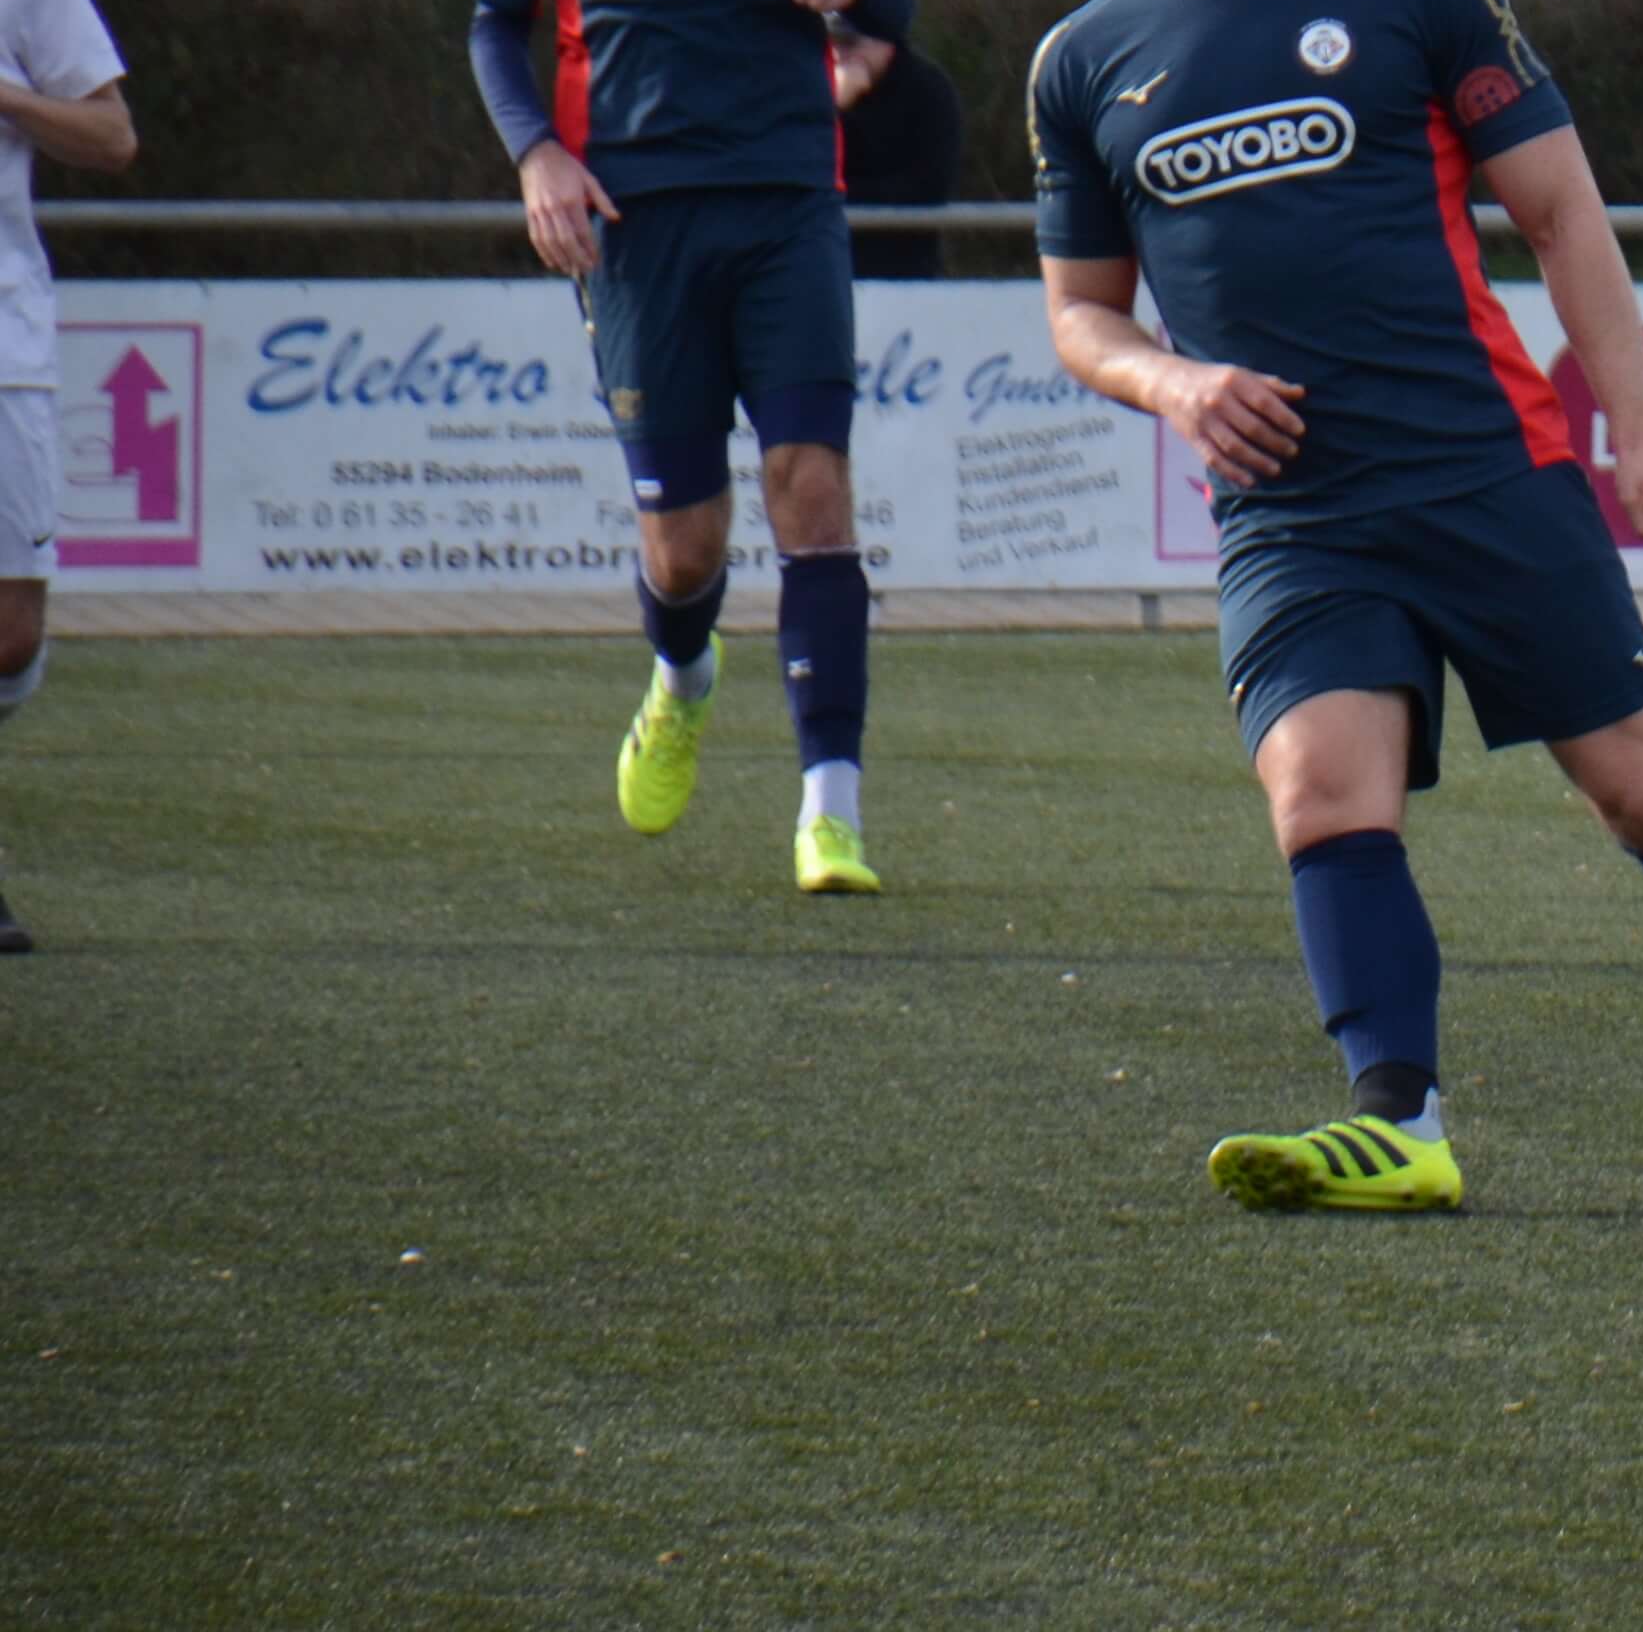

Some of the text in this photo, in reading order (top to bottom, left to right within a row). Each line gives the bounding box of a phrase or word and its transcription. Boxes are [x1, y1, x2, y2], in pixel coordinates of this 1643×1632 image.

[1149, 112, 1338, 188] TOYOBO
[246, 316, 549, 413] Elektro
[423, 460, 583, 486] Bodenheim
